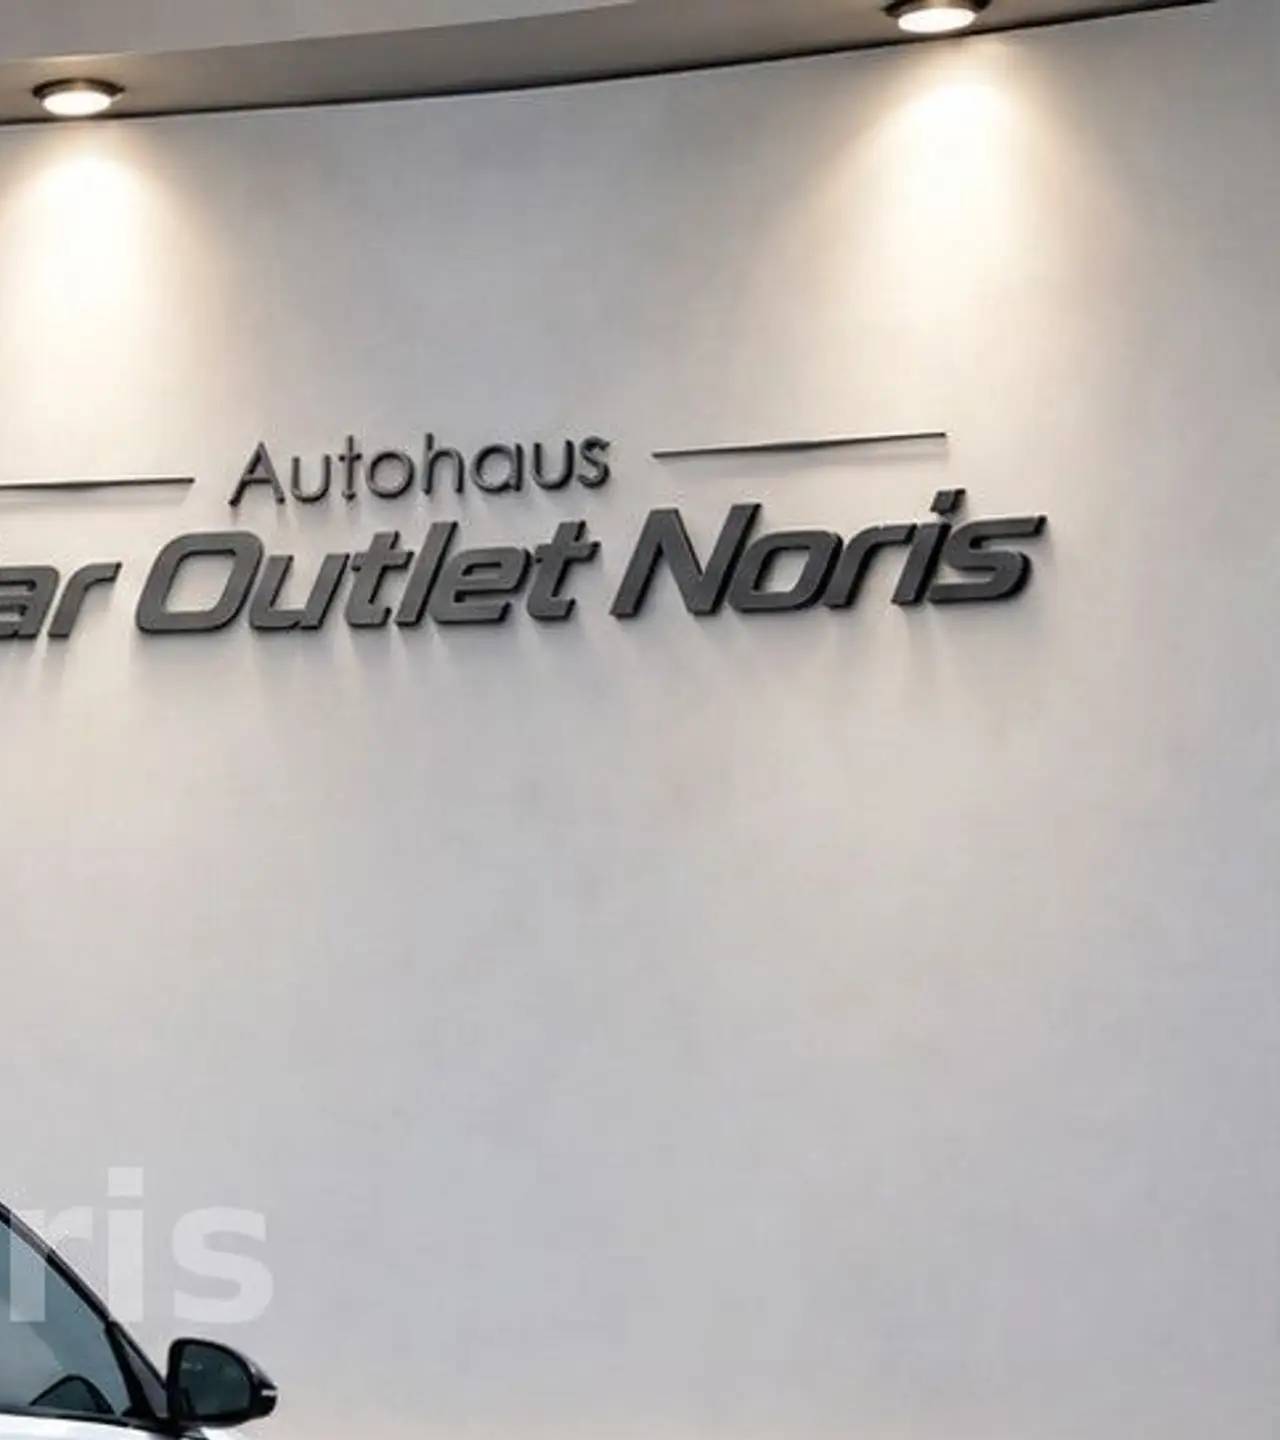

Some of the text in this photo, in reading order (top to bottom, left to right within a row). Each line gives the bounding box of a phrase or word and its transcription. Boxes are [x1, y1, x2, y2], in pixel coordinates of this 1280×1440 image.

[230, 433, 611, 505] Autohaus
[136, 520, 600, 633] Outlet
[611, 488, 1047, 618] Noris
